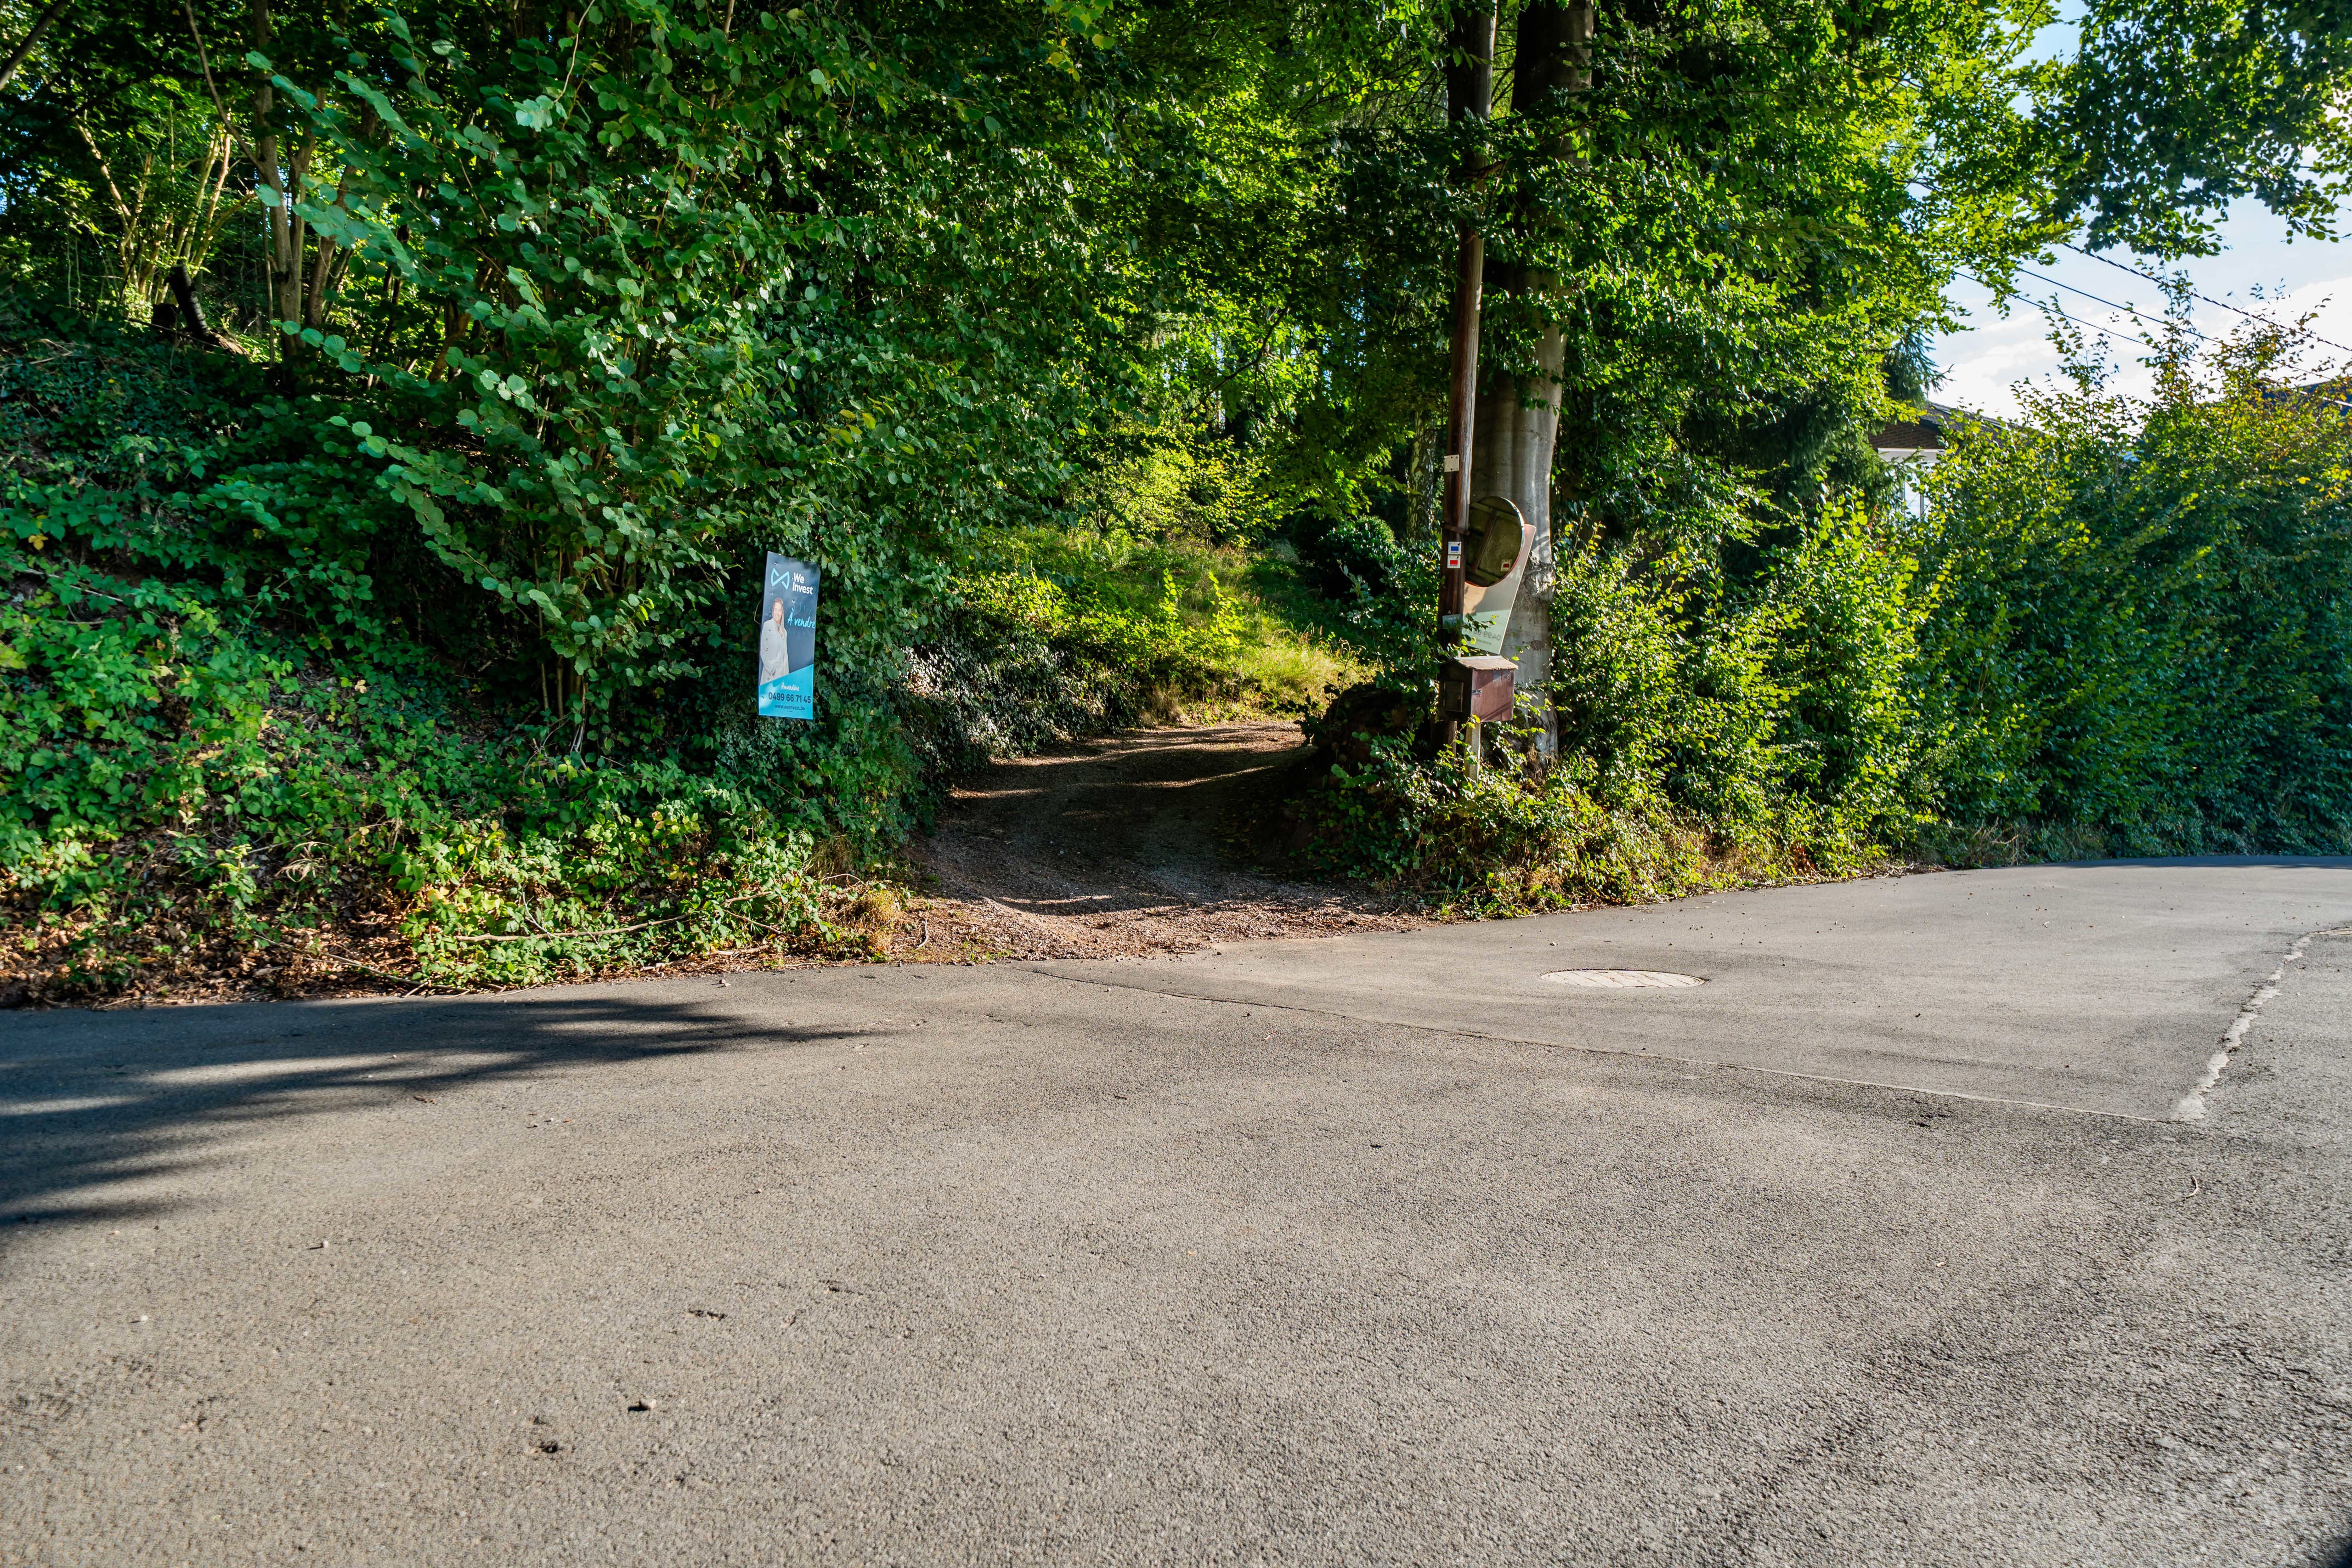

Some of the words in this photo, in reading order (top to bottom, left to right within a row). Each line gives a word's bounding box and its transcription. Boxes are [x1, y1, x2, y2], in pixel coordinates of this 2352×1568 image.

[793, 572, 804, 584] We
[792, 582, 813, 594] Invest
[787, 607, 794, 626] À
[794, 616, 815, 629] vendre
[769, 692, 785, 701] 0499
[786, 694, 794, 702] 66
[795, 695, 802, 703] 71
[803, 696, 811, 704] 45
